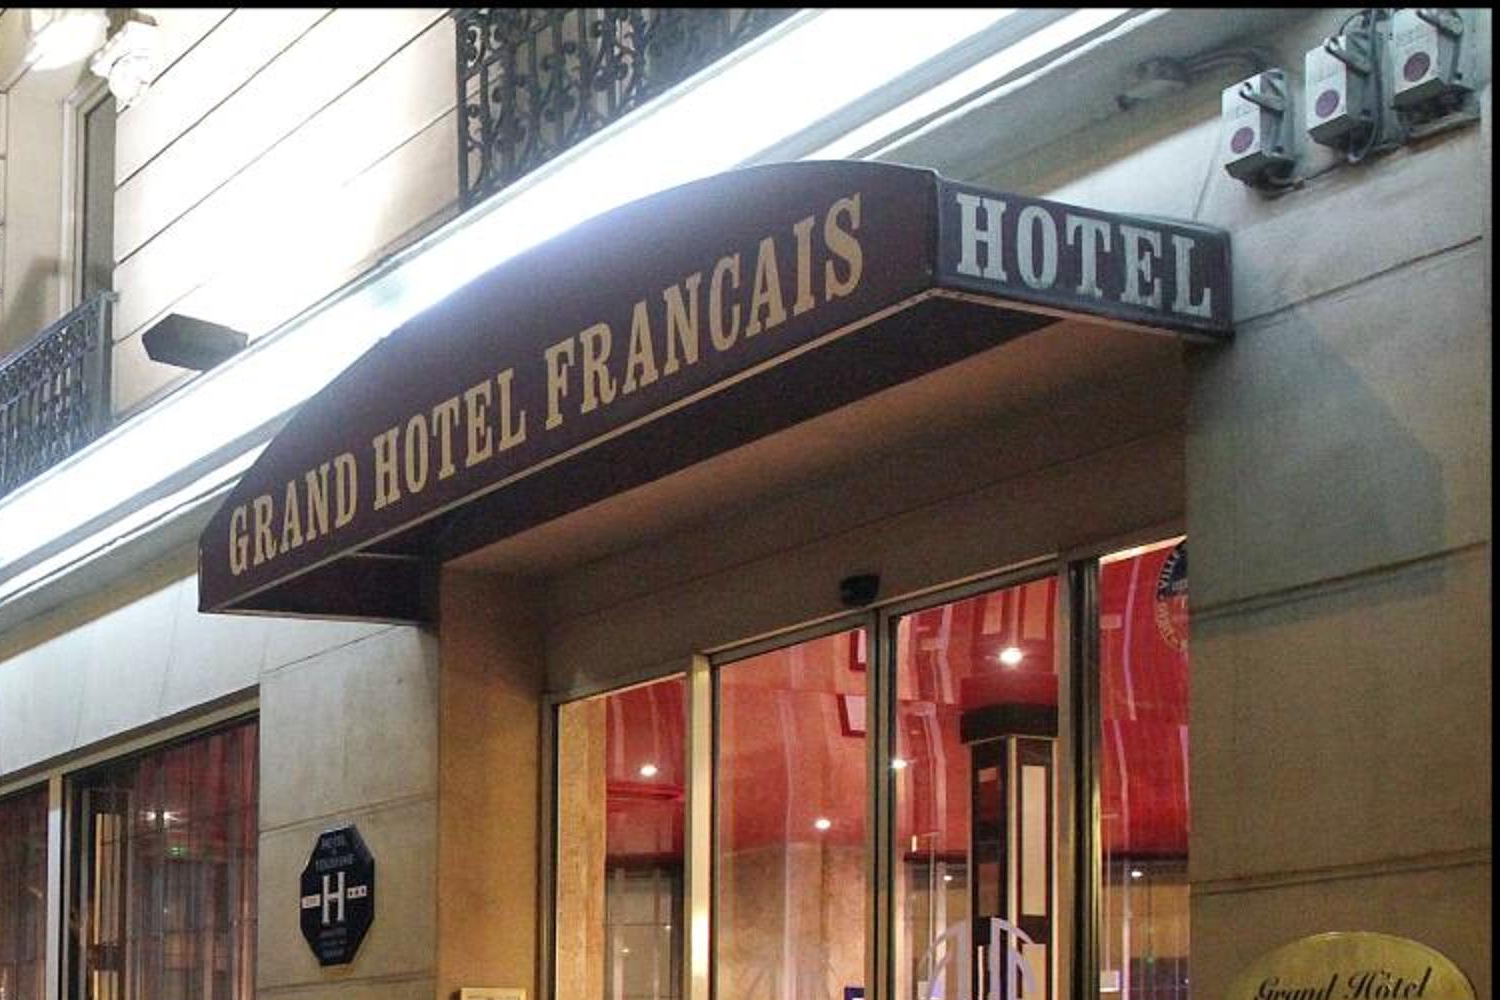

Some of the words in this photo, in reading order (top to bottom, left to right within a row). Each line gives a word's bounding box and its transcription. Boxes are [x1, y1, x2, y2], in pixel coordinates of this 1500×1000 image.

[956, 192, 1213, 318] HOTEL
[229, 452, 357, 576] GRAND
[372, 368, 527, 511] HOTEL
[544, 192, 863, 430] FRANCAIS
[322, 871, 346, 924] H
